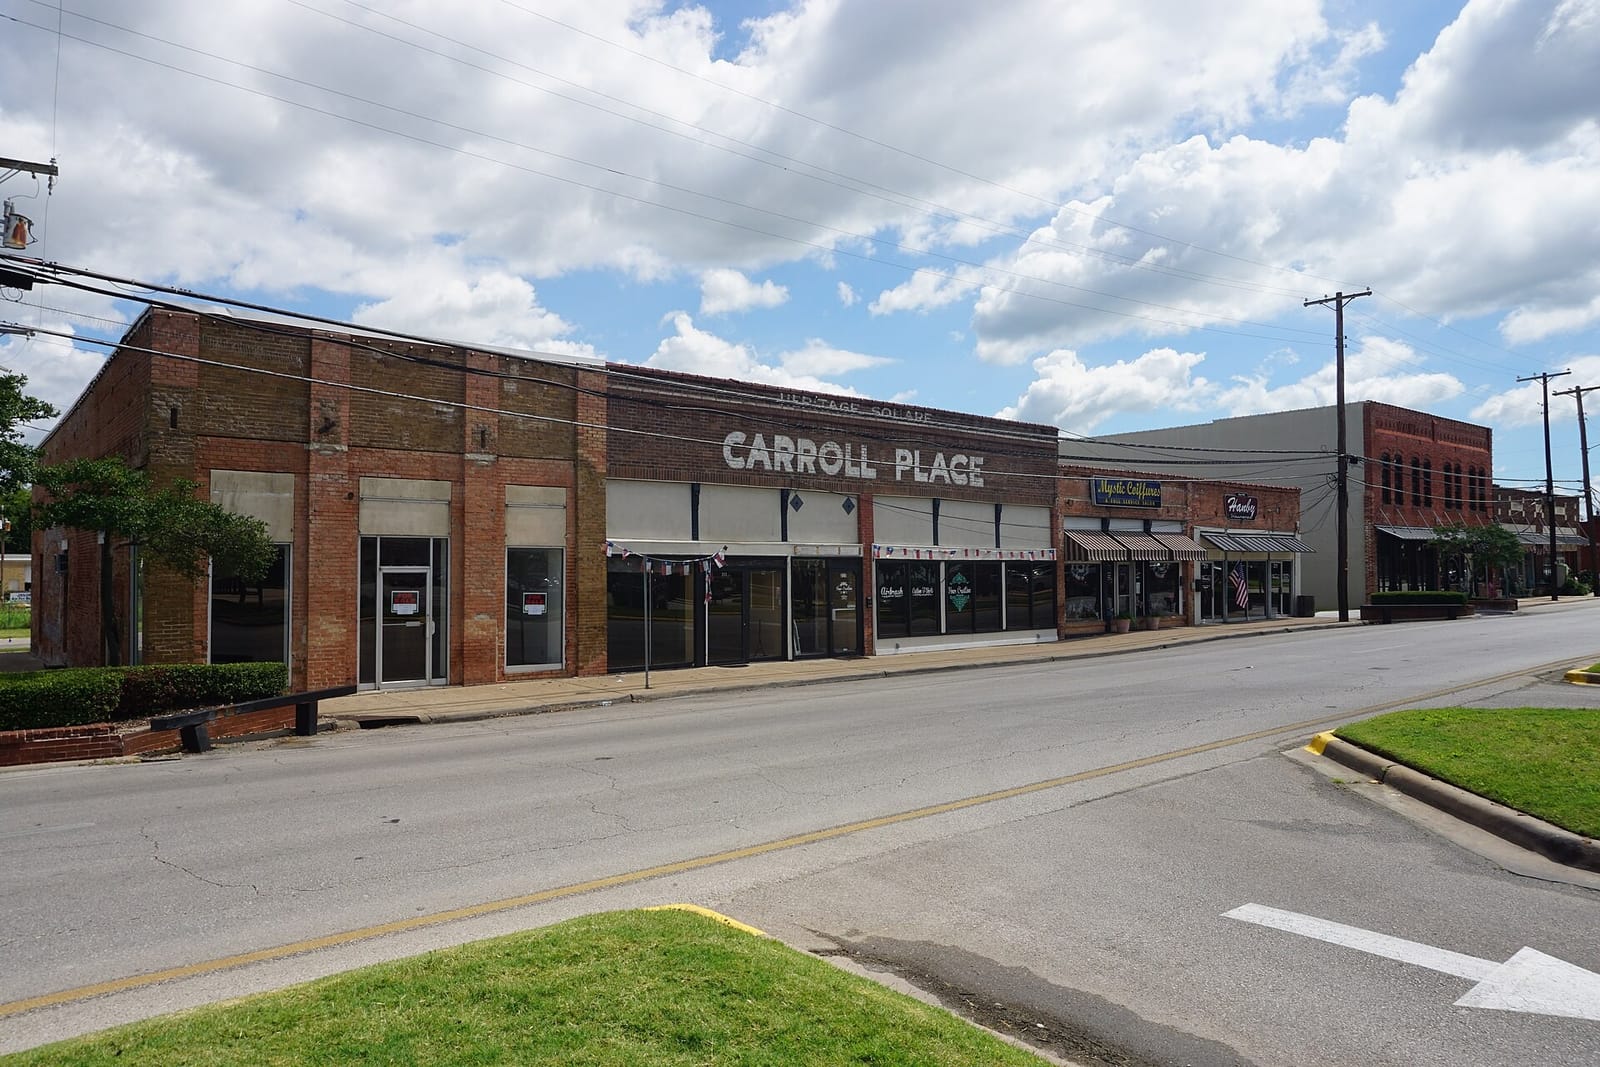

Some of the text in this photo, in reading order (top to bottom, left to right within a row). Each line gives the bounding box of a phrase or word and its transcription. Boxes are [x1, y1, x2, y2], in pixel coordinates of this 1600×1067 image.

[722, 431, 984, 487] CARROLL PLACE
[1097, 479, 1161, 500] Mystic Coiffures
[1227, 496, 1255, 519] Hanby
